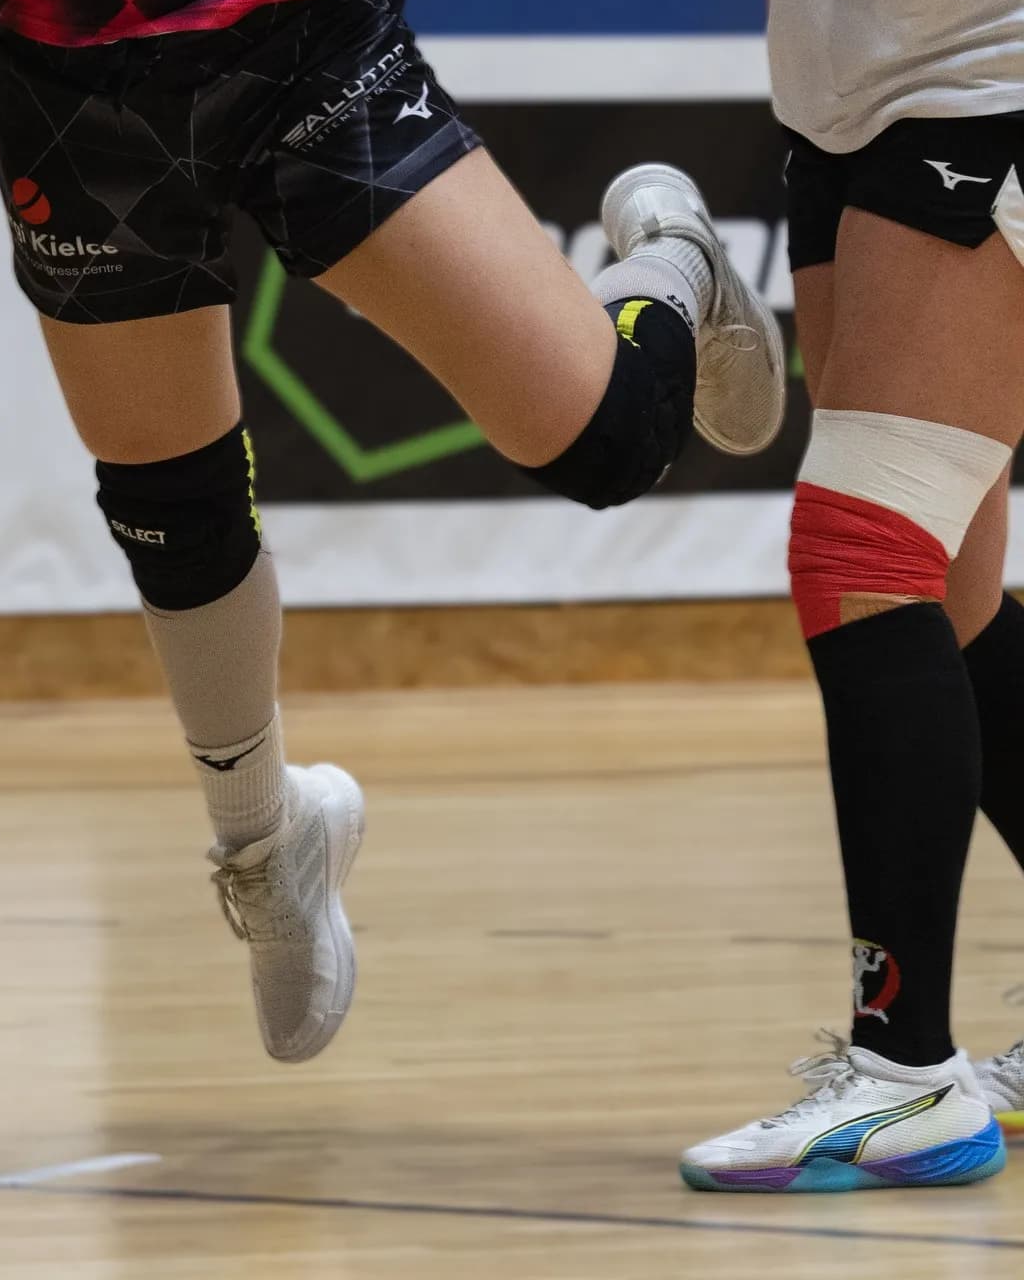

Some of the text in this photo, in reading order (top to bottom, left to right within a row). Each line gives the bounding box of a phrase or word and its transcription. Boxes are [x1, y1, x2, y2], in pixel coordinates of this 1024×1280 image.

[31, 230, 119, 257] Kielce
[82, 263, 124, 276] centre
[111, 520, 166, 545] SELECT
